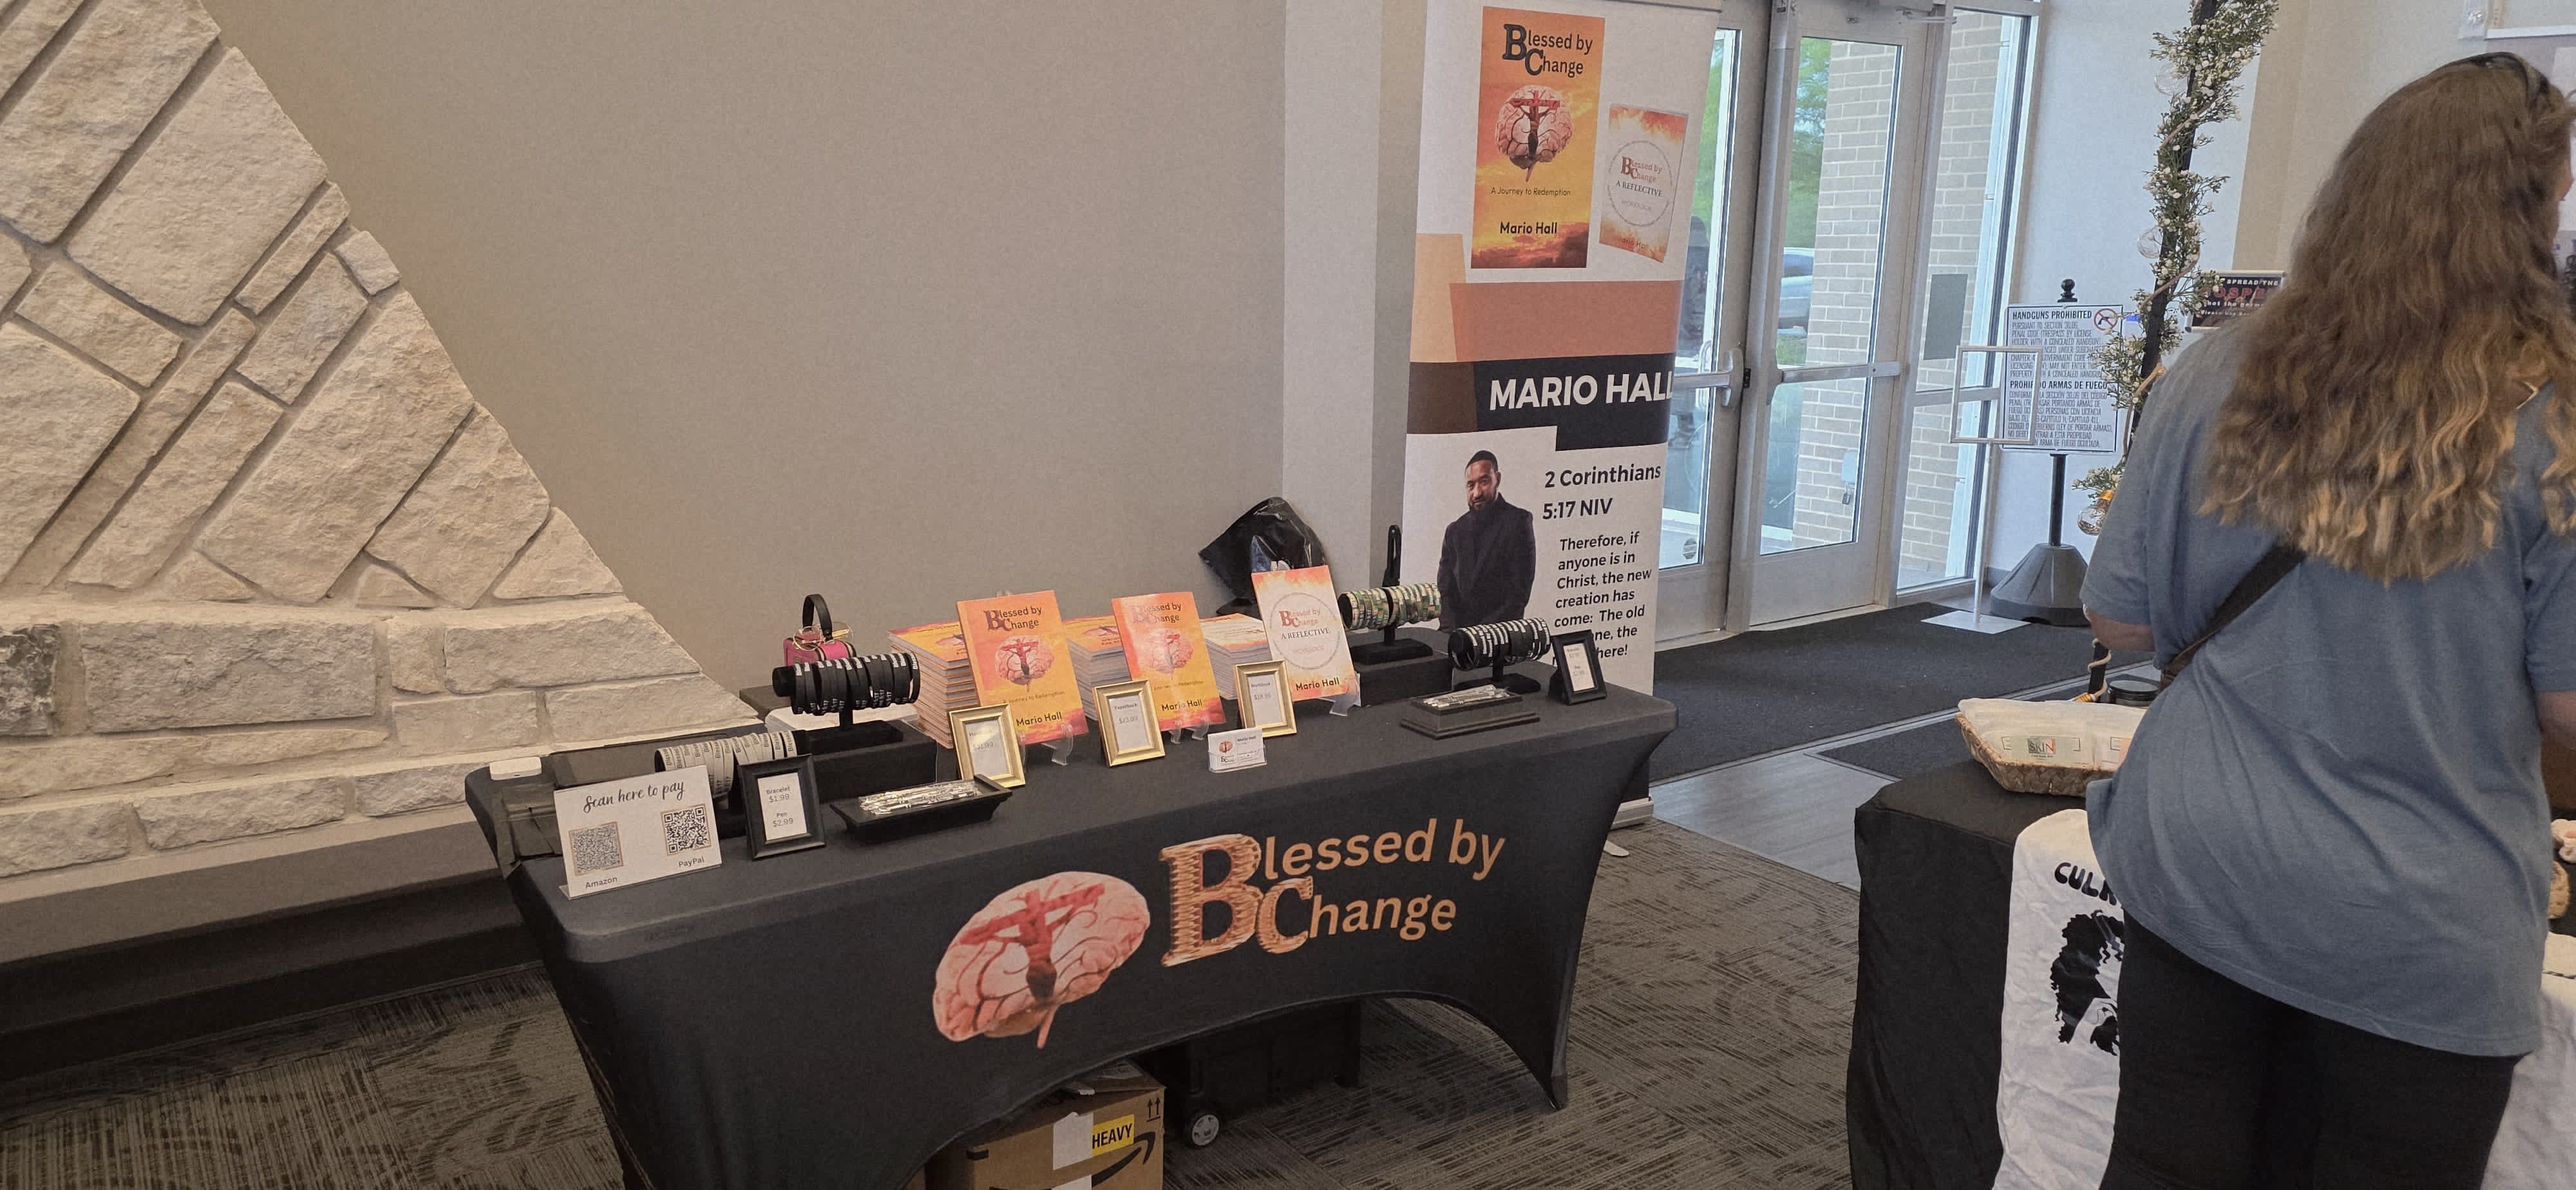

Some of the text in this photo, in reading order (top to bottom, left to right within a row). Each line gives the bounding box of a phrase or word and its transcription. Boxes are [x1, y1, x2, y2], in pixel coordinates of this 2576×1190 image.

[1502, 23, 1593, 61] Blessed by
[1524, 48, 1584, 78] Change
[1620, 156, 1663, 175] Blessed by
[1630, 168, 1657, 183] Change
[1497, 187, 1524, 197] Journey
[1533, 187, 1571, 198] Redemption
[1622, 181, 1663, 197] REFLECTIVE
[1500, 222, 1557, 234] Mario Hall
[2012, 310, 2092, 320] HANDGUNS PROHIBITED
[1490, 371, 1673, 411] MARIO HALL
[2010, 381, 2047, 390] PROHIDO
[2074, 381, 2083, 390] DE
[2085, 381, 2108, 390] FUEGO
[1545, 464, 1661, 488] 2 Corinthians
[1542, 498, 1613, 520] 5:17 NIV
[1560, 531, 1640, 552] Therefore, if
[1558, 552, 1636, 572] anyone is in
[1557, 569, 1653, 590] Christ, the new
[1171, 602, 1182, 612] by
[1555, 590, 1635, 609] creation has
[983, 606, 1042, 631] Blessed by
[1279, 610, 1311, 627] Blessed
[1291, 617, 1318, 628] Change
[1554, 605, 1645, 628] come: The old
[999, 618, 1039, 632] Change
[1287, 627, 1331, 639] REFLECTIVE
[1593, 626, 1638, 643] ne, the
[1595, 644, 1628, 660] here!
[1295, 677, 1340, 691] Mario Hall
[1161, 699, 1202, 712] Mario Hall
[1016, 712, 1062, 727] Mario Hall
[2029, 741, 2054, 753] SKIN
[583, 781, 686, 813] Scan here to pay
[766, 786, 791, 795] Bracelet
[769, 793, 790, 804] $1.99
[772, 817, 794, 829] $2.99
[678, 856, 705, 869] PayPal
[585, 876, 618, 889] Amazon
[1159, 818, 1505, 968] Blessed by
[1256, 875, 1457, 954] Change
[1092, 1122, 1133, 1149] HEAVY
